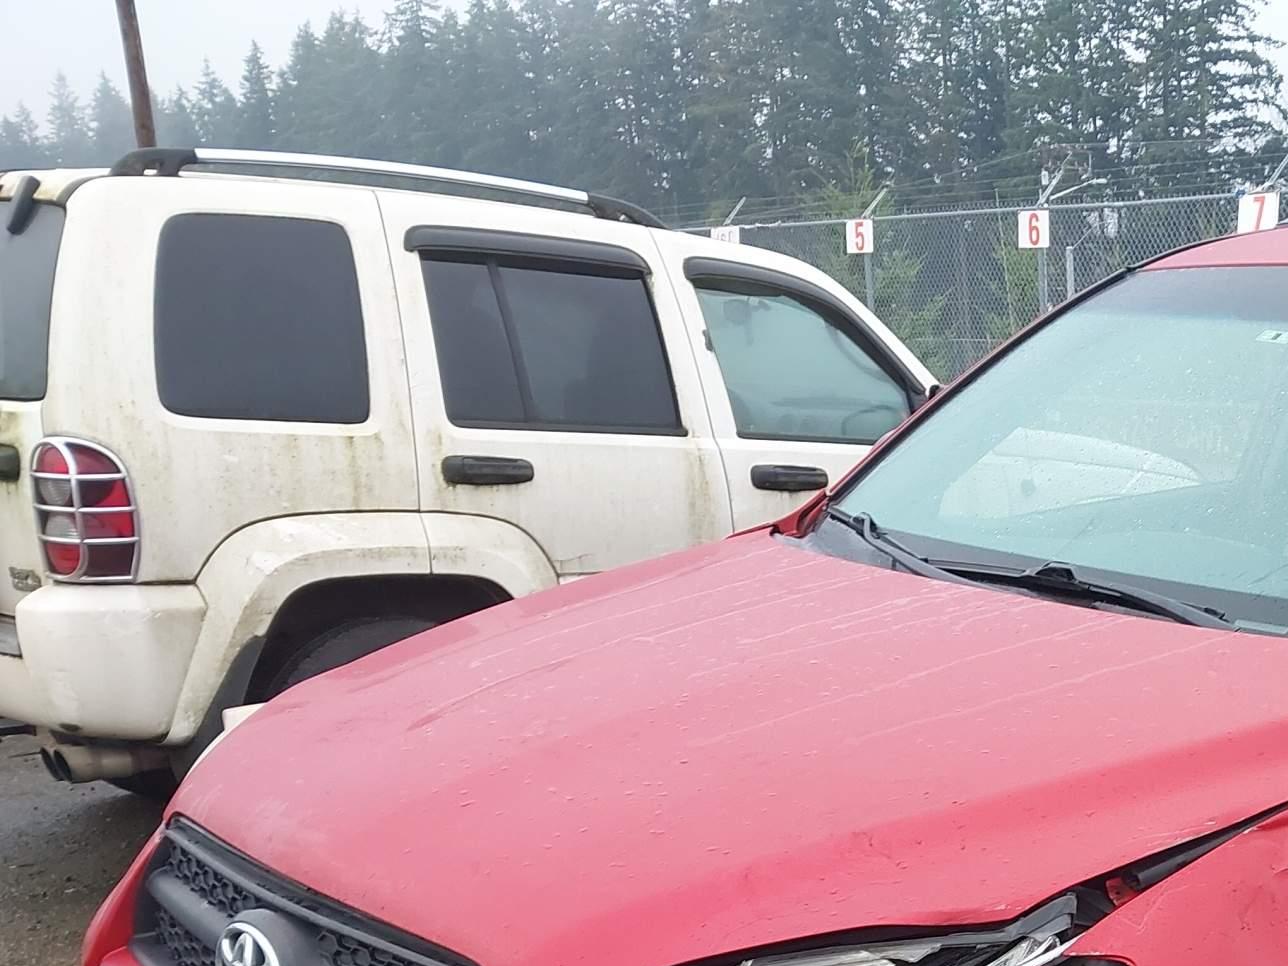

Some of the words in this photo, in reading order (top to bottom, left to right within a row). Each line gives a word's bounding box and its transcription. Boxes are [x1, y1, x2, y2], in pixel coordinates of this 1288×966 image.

[1029, 212, 1040, 245] 6
[1253, 196, 1265, 232] 7
[855, 221, 865, 251] 5
